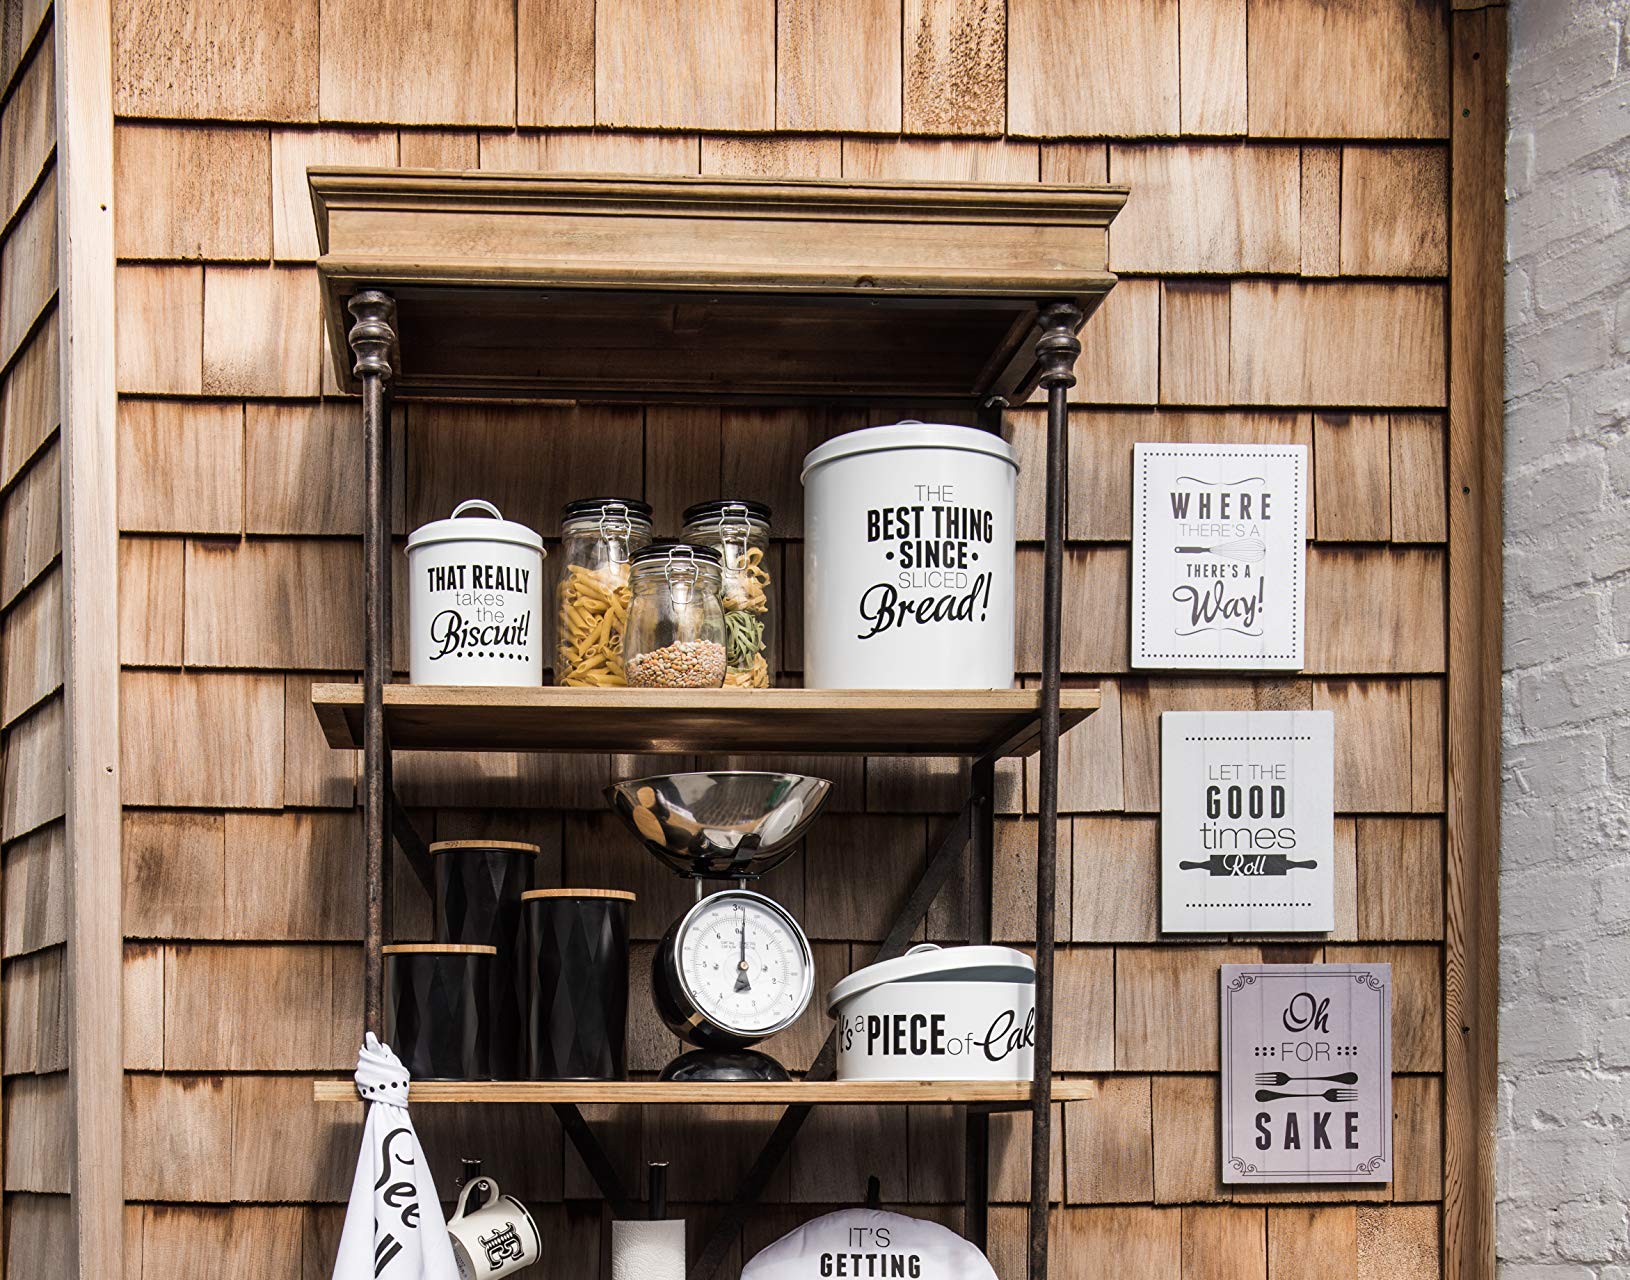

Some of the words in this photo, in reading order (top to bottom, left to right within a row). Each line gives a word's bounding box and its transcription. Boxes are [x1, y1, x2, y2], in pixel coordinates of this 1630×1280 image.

[914, 485, 953, 502] THE
[1170, 492, 1271, 520] WHERE
[867, 506, 925, 542] BEST
[932, 506, 993, 543] THING
[1179, 523, 1245, 537] THERE'S
[1249, 524, 1260, 537] A
[900, 540, 967, 569] SINCE
[427, 565, 466, 592] THAT
[472, 565, 529, 594] REALLY
[899, 571, 968, 588] SLICED
[1186, 564, 1239, 578] THERE'S
[1244, 564, 1251, 578] A
[455, 590, 504, 606] takes
[857, 572, 992, 639] Bread!
[1172, 576, 1264, 628] Way!
[476, 607, 504, 623] the
[429, 610, 530, 660] Biscuit!
[1209, 765, 1243, 780] LET
[1248, 765, 1286, 780] THE
[1206, 785, 1285, 819] GOOD
[1200, 822, 1296, 849] times
[1223, 853, 1267, 877] Roll
[1283, 992, 1330, 1033] Oh
[839, 1012, 853, 1053] t's
[855, 1015, 865, 1032] a
[867, 1014, 945, 1055] PIECE
[947, 1032, 974, 1055] of
[974, 1006, 1034, 1062] Cak
[1281, 1042, 1330, 1062] FOR
[1255, 1111, 1359, 1150] SAKE
[849, 1227, 890, 1248] IT'S
[820, 1253, 921, 1279] GETTING
